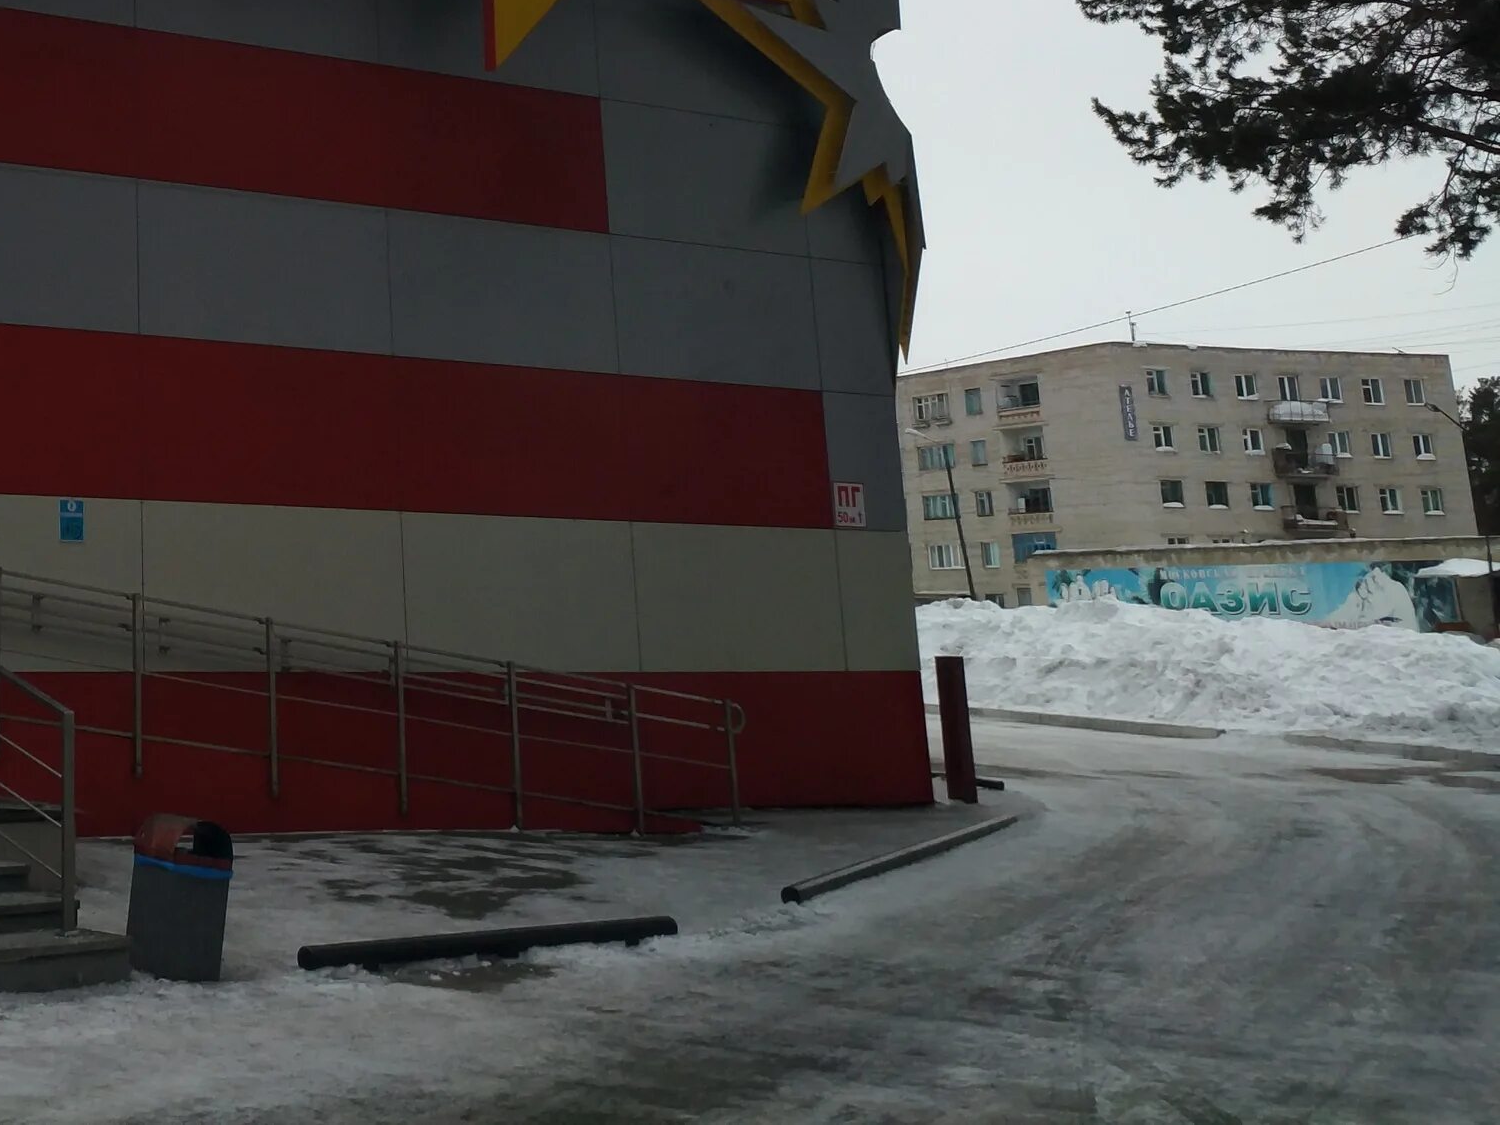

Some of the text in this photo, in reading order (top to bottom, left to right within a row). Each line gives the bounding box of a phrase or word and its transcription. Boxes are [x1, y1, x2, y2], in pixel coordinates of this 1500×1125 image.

[1124, 388, 1136, 437] АТЕЛЬЕ
[837, 486, 860, 507] ПГ
[1160, 582, 1312, 615] ОАЗИС
